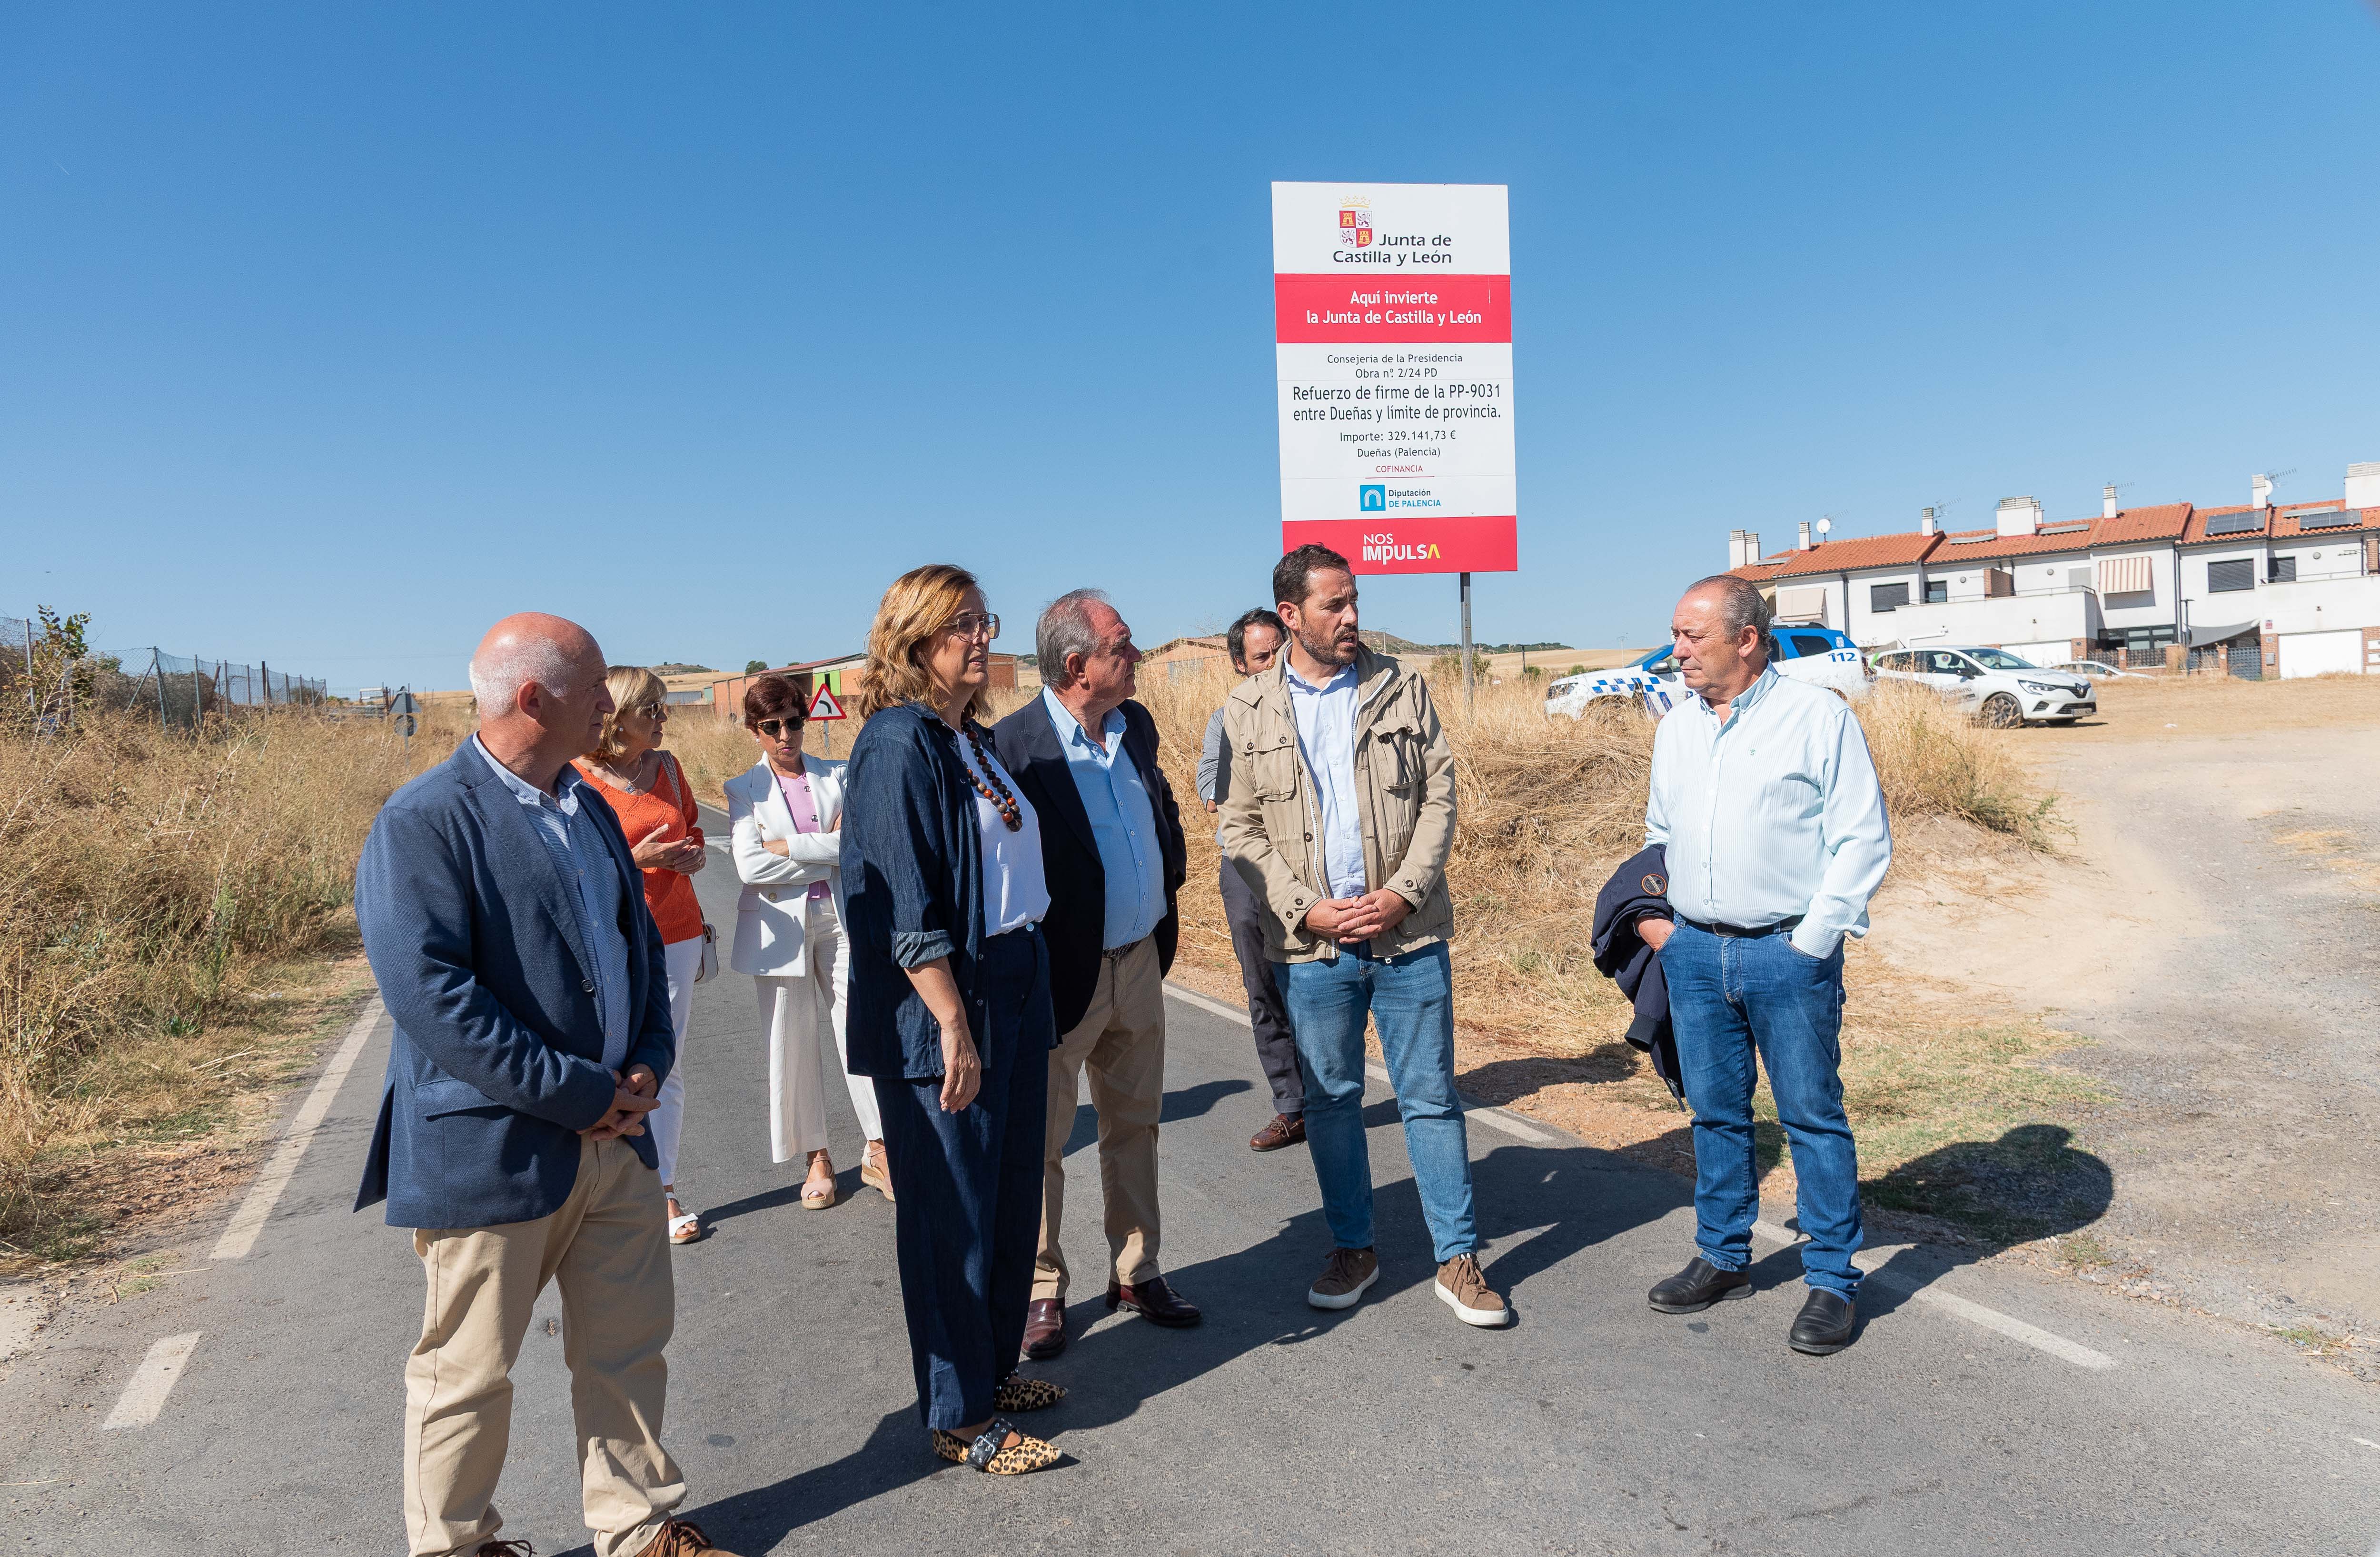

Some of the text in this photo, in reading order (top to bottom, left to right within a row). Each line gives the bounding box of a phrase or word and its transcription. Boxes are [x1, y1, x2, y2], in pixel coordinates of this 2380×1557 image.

[1378, 234, 1451, 246] Junta de
[1333, 250, 1451, 267] Castilla y León
[1350, 290, 1438, 307] Aquí invierte
[1306, 309, 1482, 327] la Junta de Castilla y León
[1327, 353, 1463, 365] Consejería de la Presidencia
[1356, 368, 1379, 378] Obra
[1398, 368, 1421, 378] 2/24
[1424, 368, 1438, 378] PD
[1293, 384, 1499, 400] Refuerzo de firme de la PP-9031
[1293, 404, 1501, 423] entre Dueñas y límite de provincia.
[1340, 430, 1456, 444] Importe: 329.141,73 €
[1358, 447, 1440, 459] Dueñas (Palencia)
[1376, 465, 1423, 473] COFINANCIA
[1388, 489, 1431, 499] Diputación
[1364, 533, 1394, 545] NOS
[1828, 652, 1857, 662] 112
